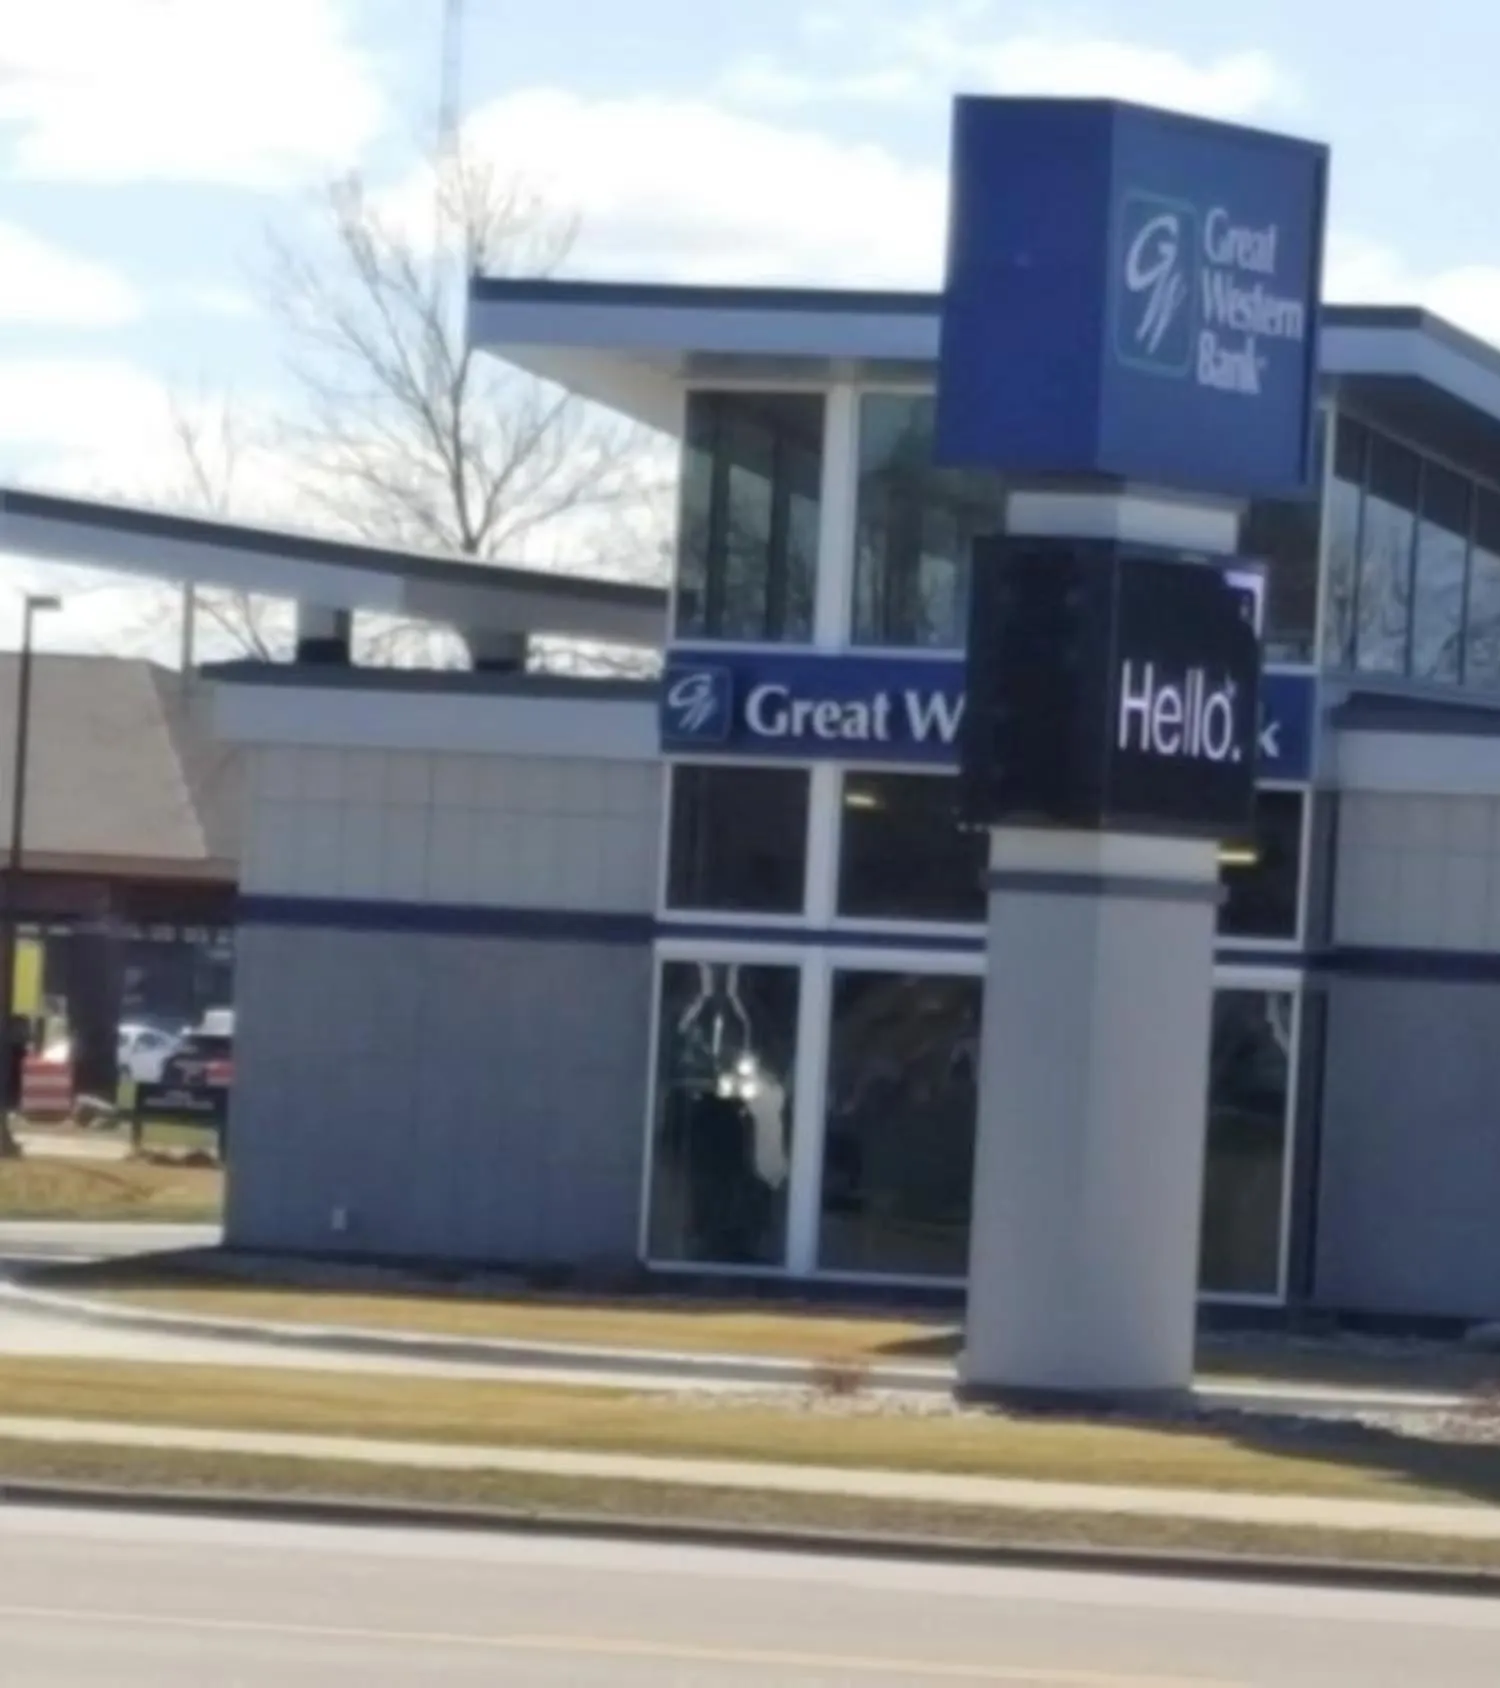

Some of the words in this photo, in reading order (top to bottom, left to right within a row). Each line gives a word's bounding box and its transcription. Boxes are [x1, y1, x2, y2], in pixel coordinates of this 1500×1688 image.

[1203, 207, 1276, 274] Great
[1201, 267, 1304, 341] Western
[1197, 330, 1261, 395] Bank
[744, 684, 892, 742] Great
